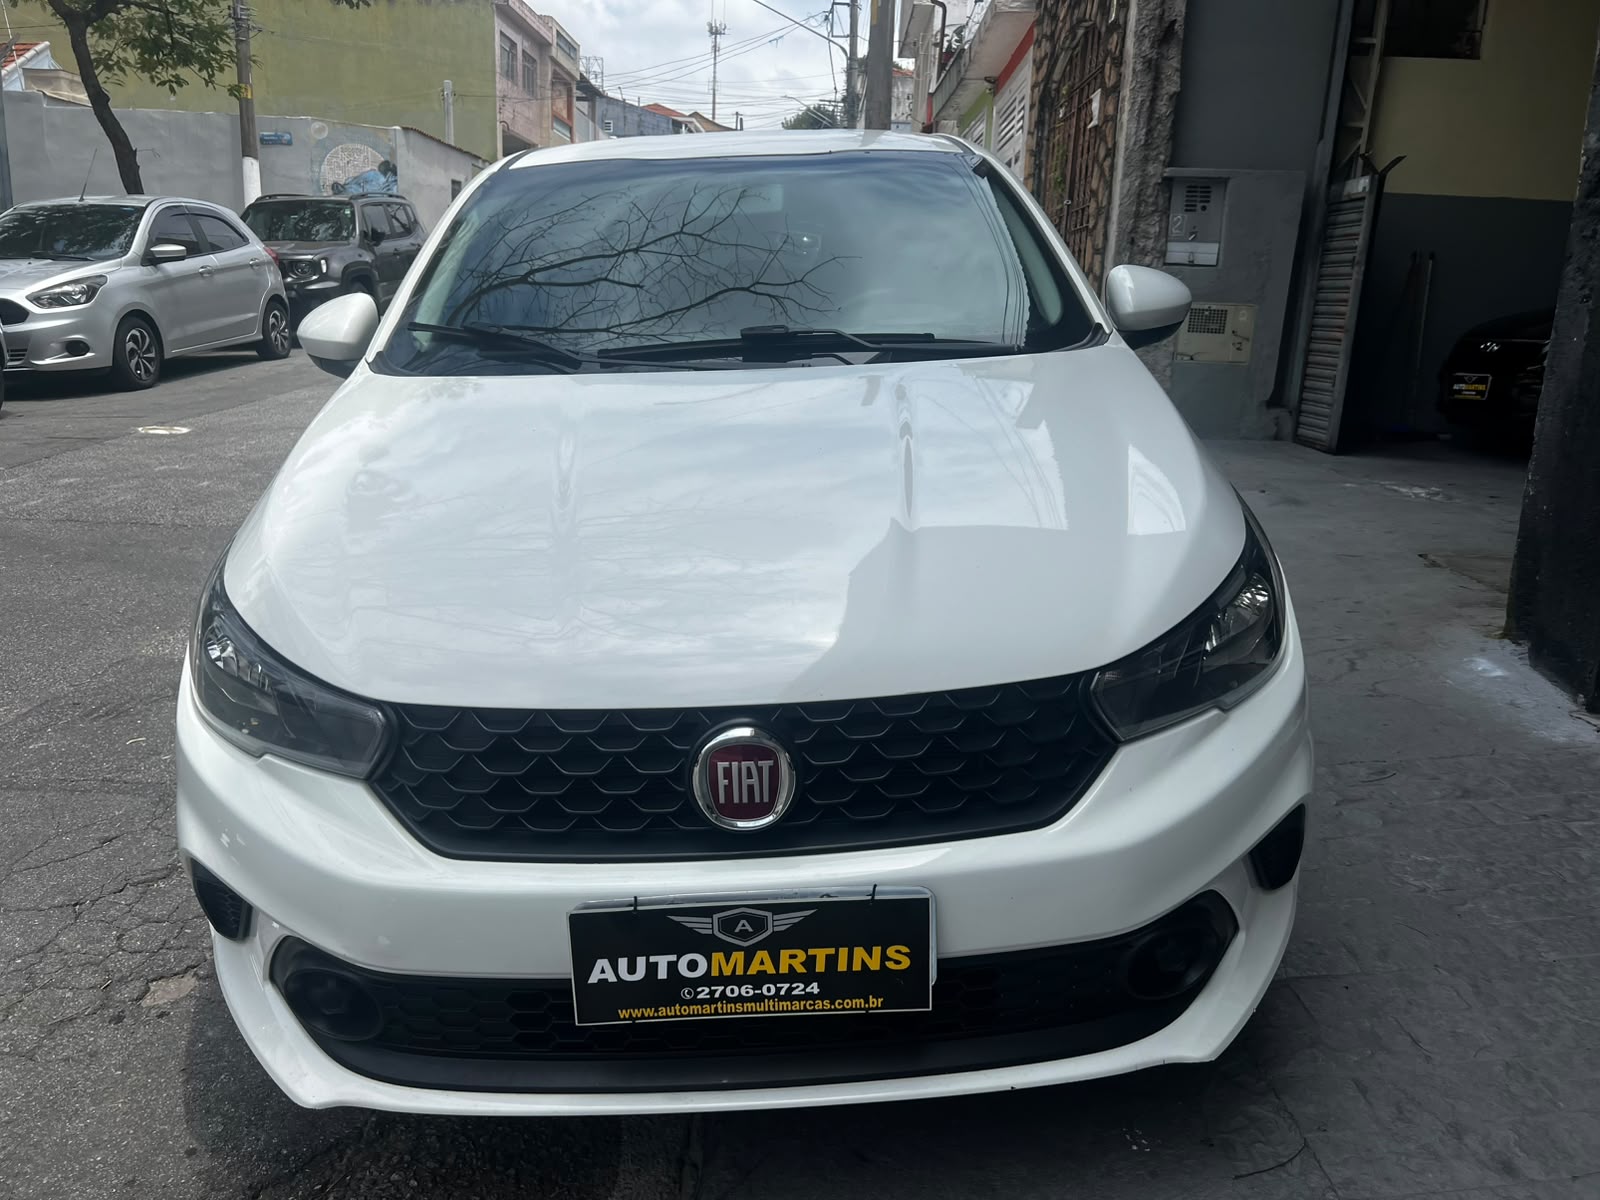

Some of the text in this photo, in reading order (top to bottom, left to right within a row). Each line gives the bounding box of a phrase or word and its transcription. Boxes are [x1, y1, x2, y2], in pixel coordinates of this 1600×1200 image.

[717, 760, 774, 804] FIAT
[734, 919, 754, 932] A
[587, 945, 911, 984] AUTOMARTINS
[696, 982, 820, 999] 2706-0724
[618, 995, 884, 1019] www.automartinsmultimarcas.com.br
